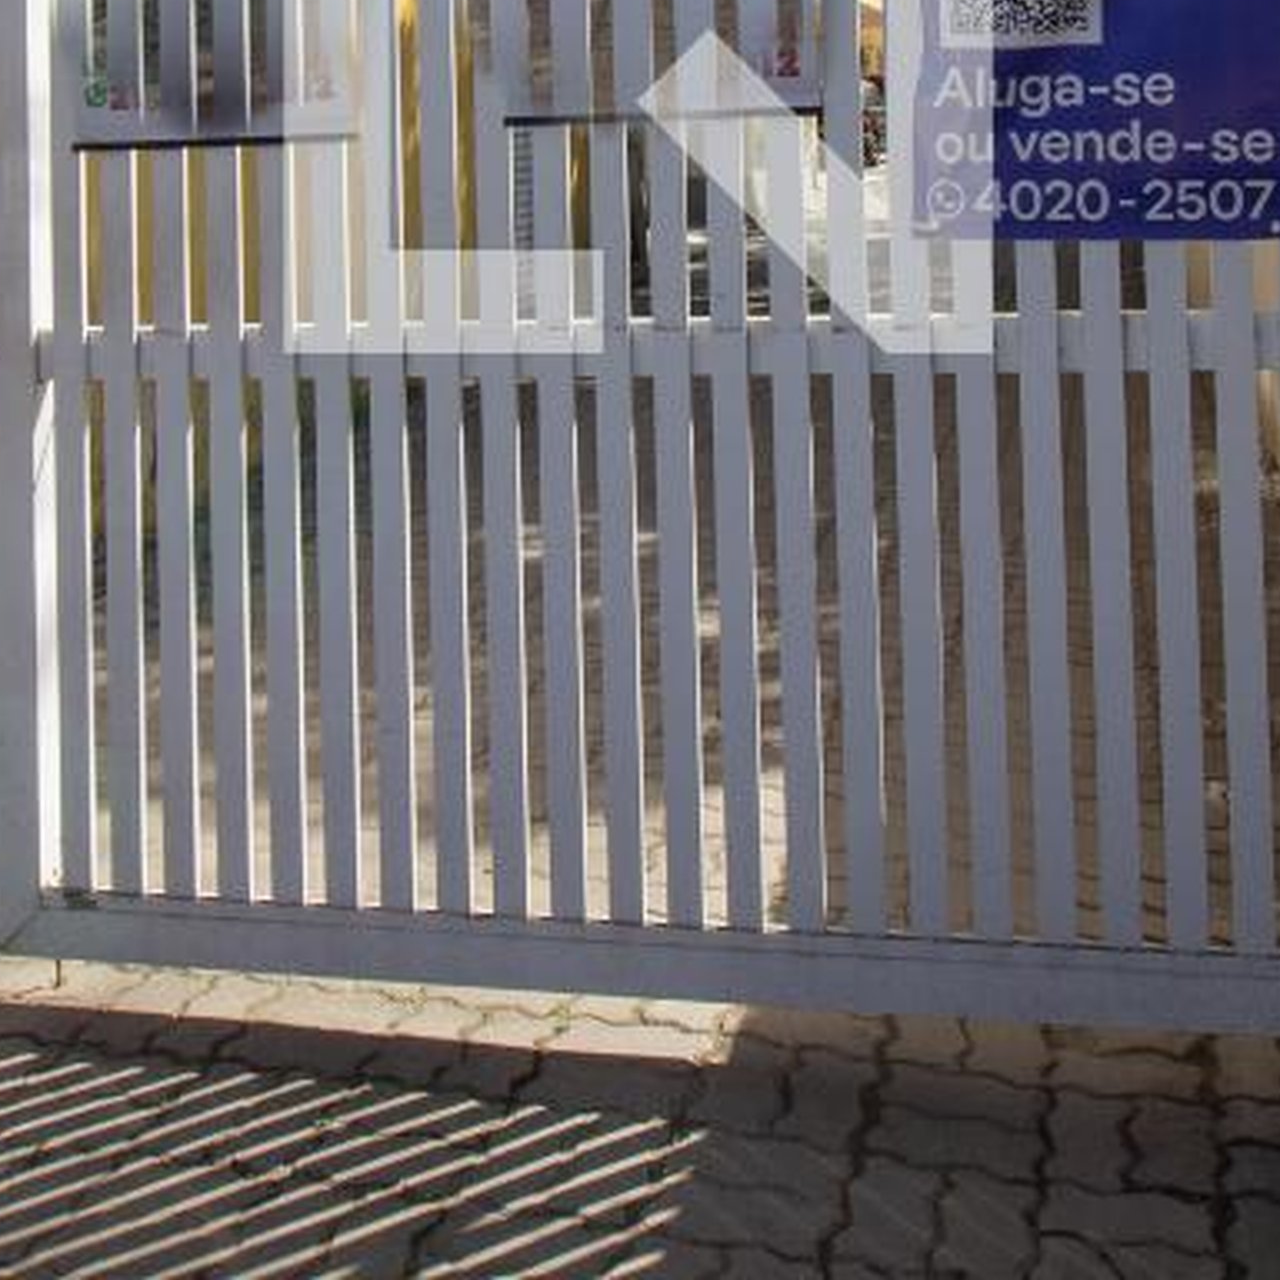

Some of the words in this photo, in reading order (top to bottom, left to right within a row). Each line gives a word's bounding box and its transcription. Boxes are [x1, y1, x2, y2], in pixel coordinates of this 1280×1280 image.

[933, 66, 1175, 116] Aluga-se
[935, 131, 993, 163] ou
[1010, 121, 1276, 163] vende-se
